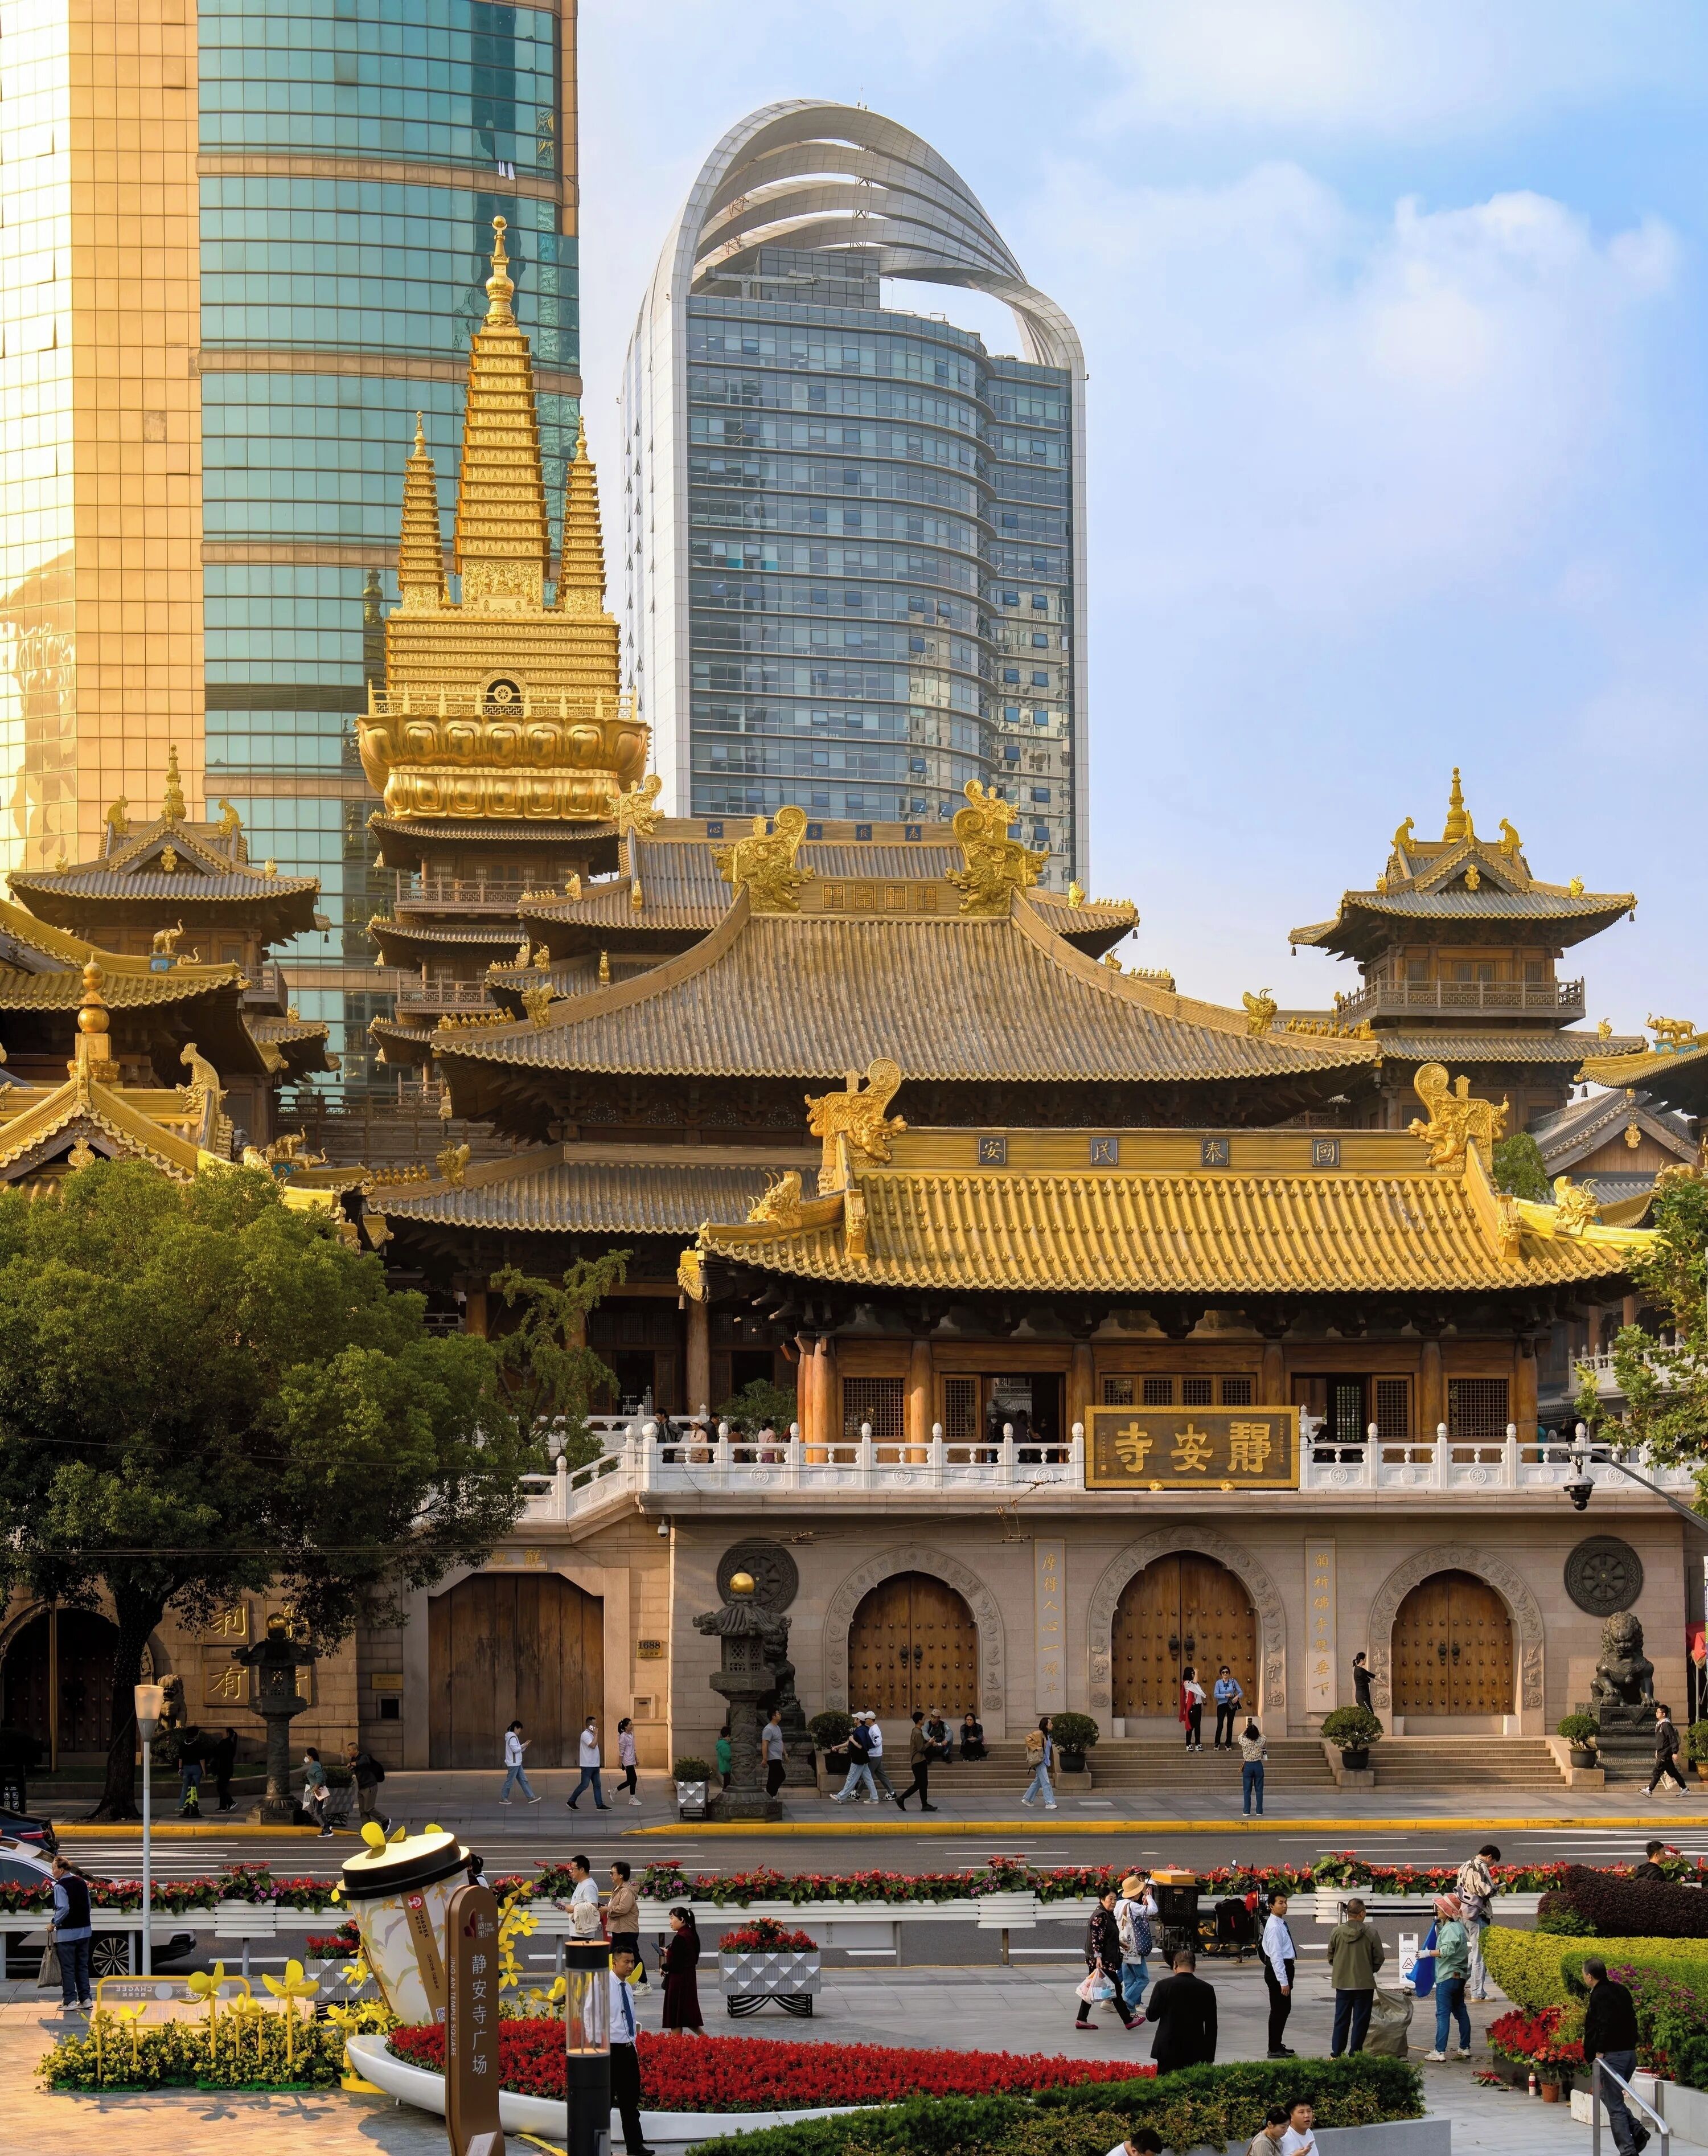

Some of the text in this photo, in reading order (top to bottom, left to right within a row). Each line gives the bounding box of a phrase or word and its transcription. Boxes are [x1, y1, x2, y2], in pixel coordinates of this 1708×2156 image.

[418, 1910, 429, 1938] CHAGEE
[450, 1977, 455, 1989] AN
[472, 1954, 487, 2075] 静安寺广场
